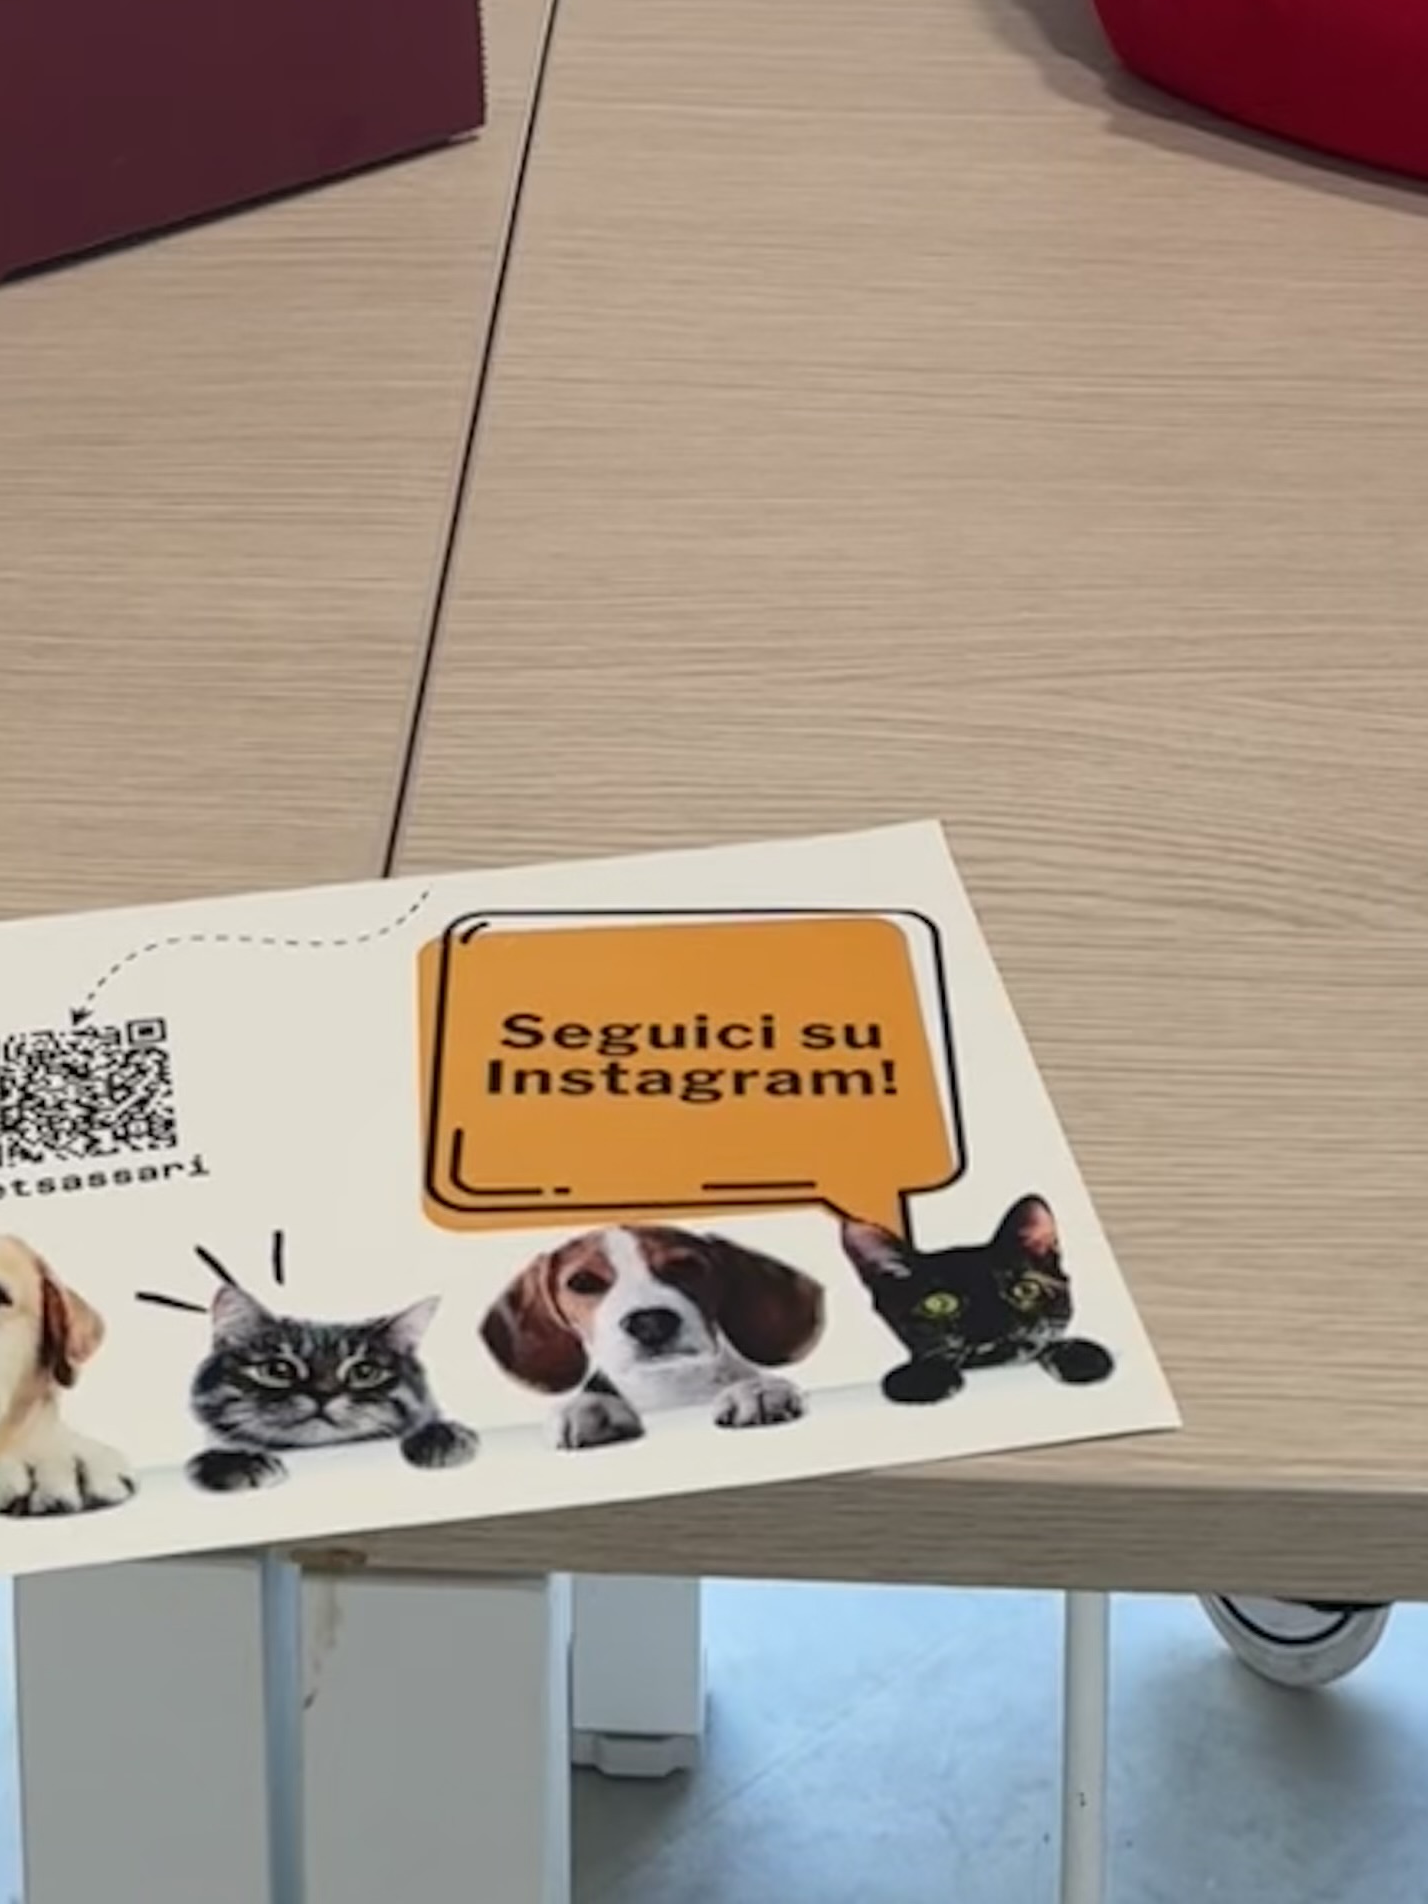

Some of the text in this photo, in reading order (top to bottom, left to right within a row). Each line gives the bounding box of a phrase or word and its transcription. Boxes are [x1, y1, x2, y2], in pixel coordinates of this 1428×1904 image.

[499, 1012, 883, 1058] Seguici su
[486, 1059, 898, 1104] Instagram!
